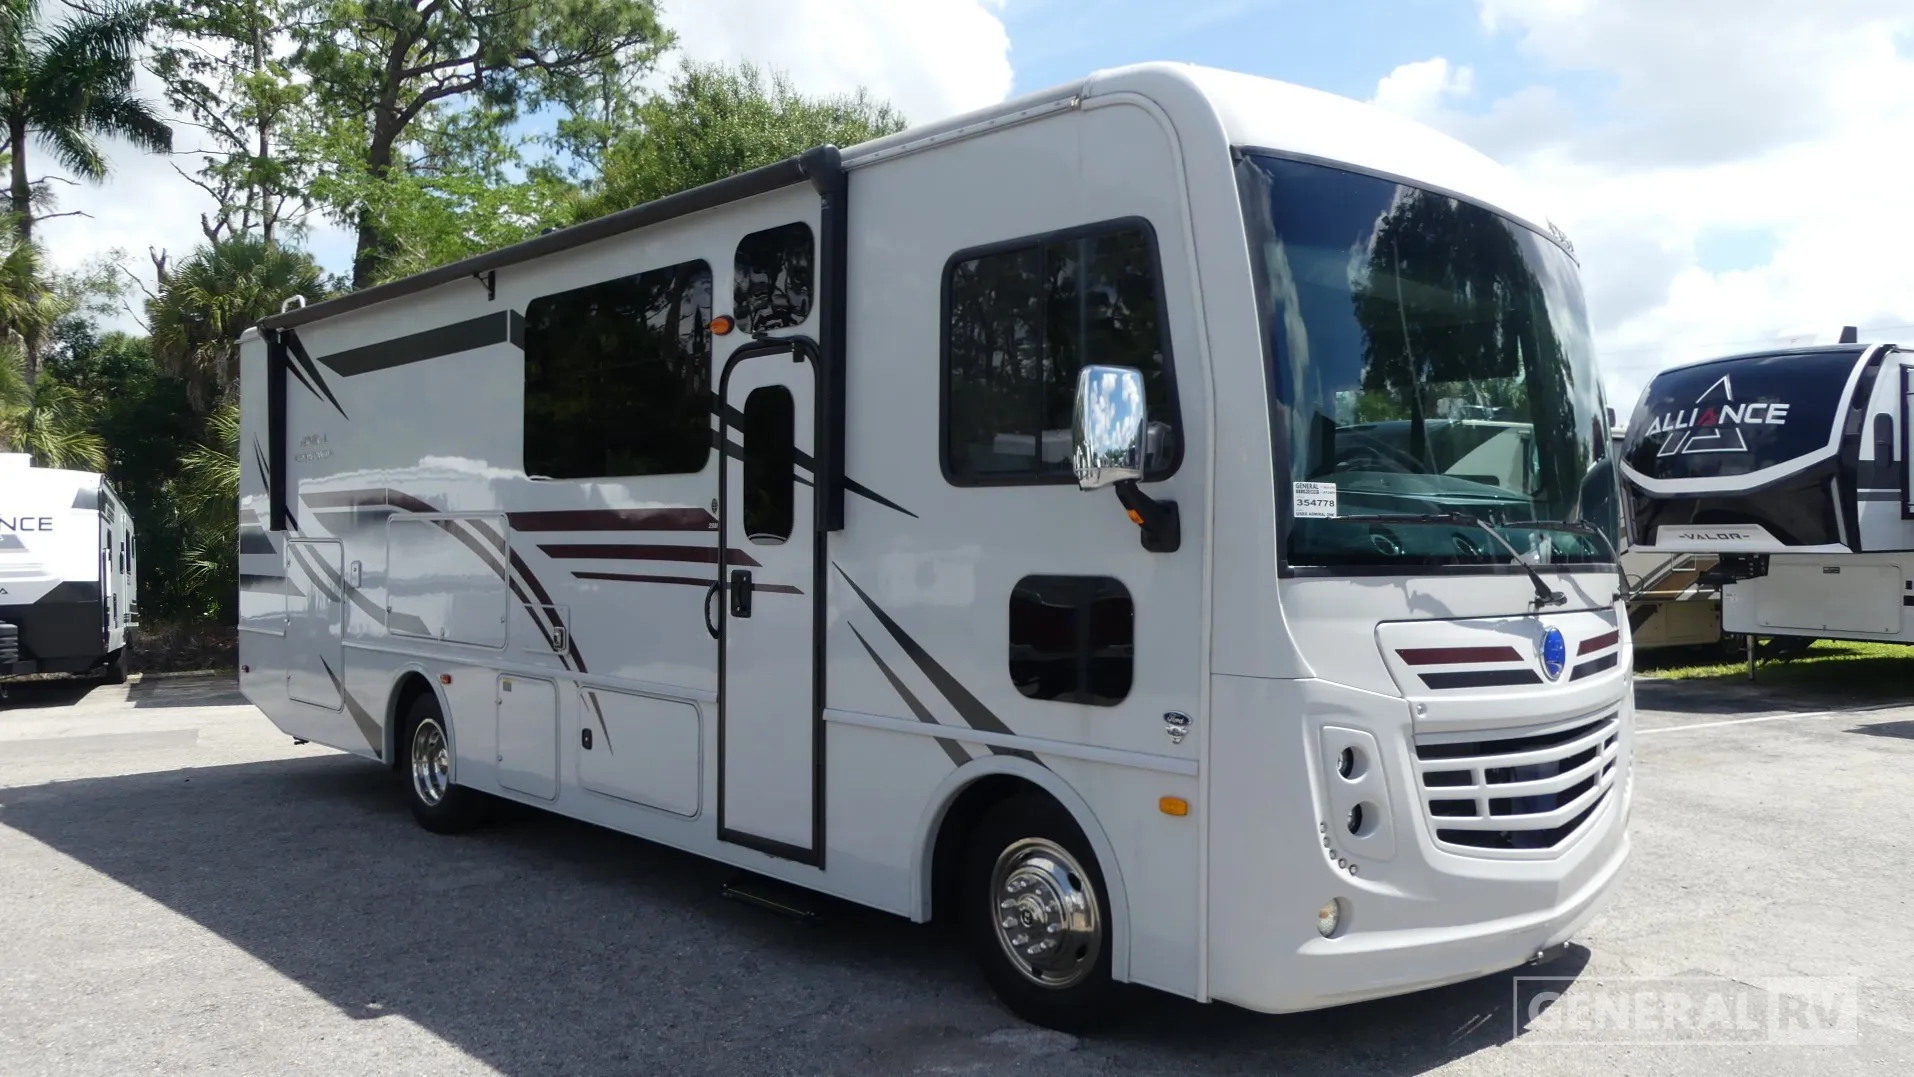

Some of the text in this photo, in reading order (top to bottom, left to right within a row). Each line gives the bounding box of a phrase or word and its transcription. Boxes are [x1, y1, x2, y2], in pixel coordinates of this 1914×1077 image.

[1645, 403, 1790, 437] ALLIANCE
[1296, 499, 1335, 507] 354778
[1167, 714, 1184, 724] Ford
